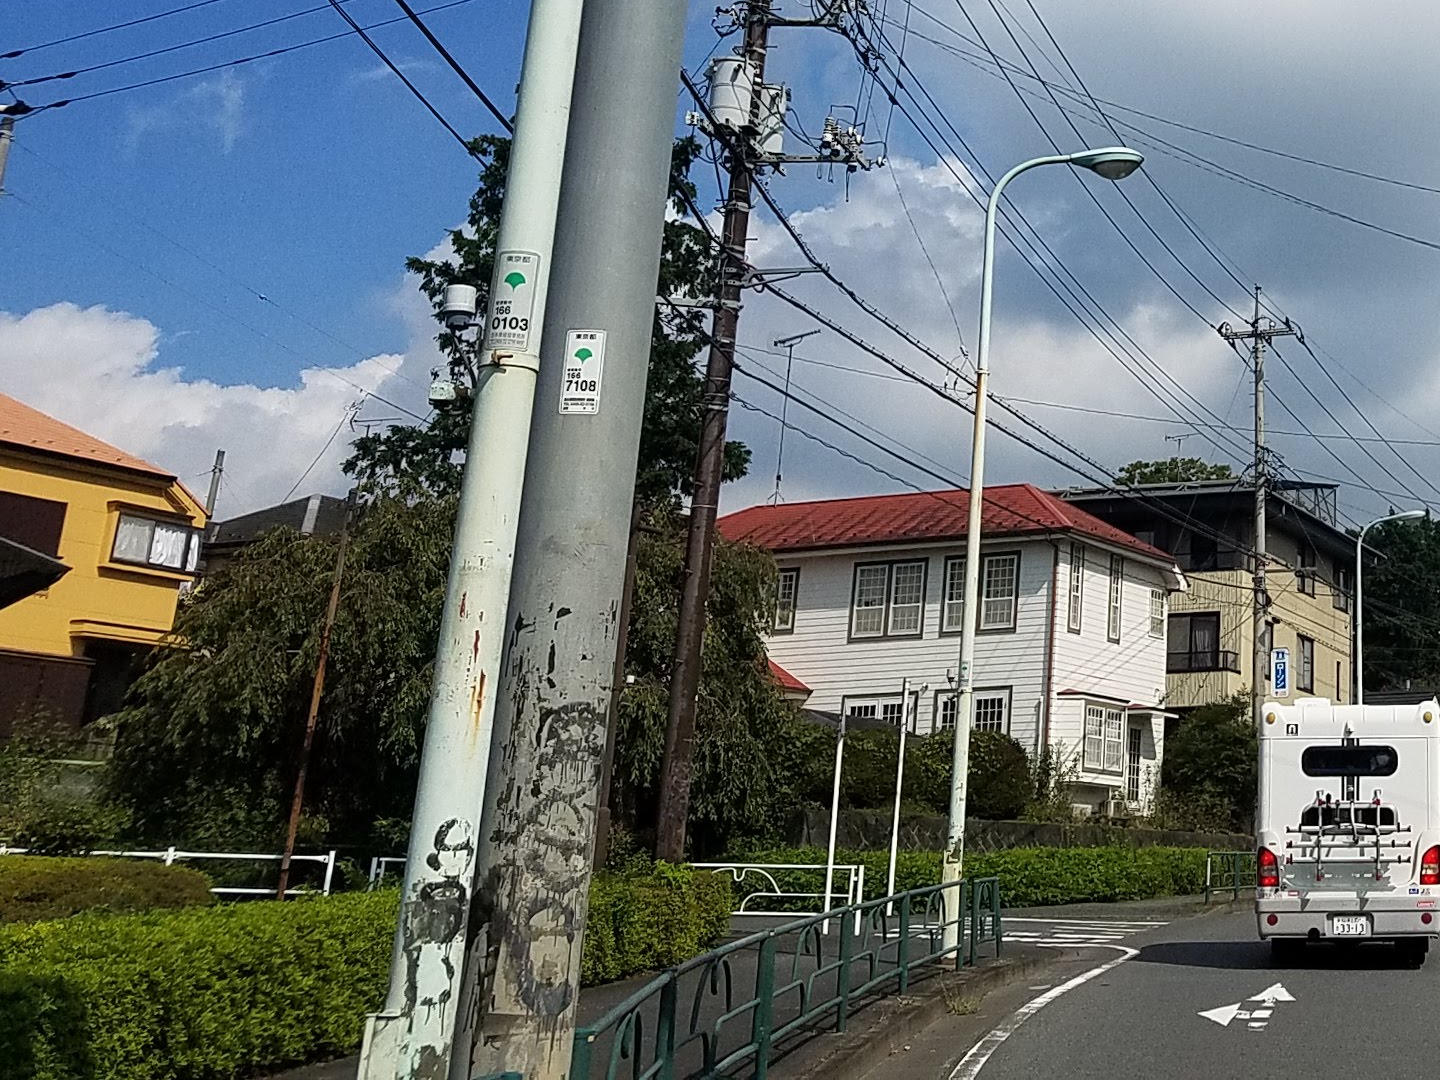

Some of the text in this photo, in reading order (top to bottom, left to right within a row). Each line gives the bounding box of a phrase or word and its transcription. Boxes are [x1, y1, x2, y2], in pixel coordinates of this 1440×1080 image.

[495, 305, 511, 315] 166
[492, 316, 529, 332] 0103
[565, 380, 597, 392] 7108
